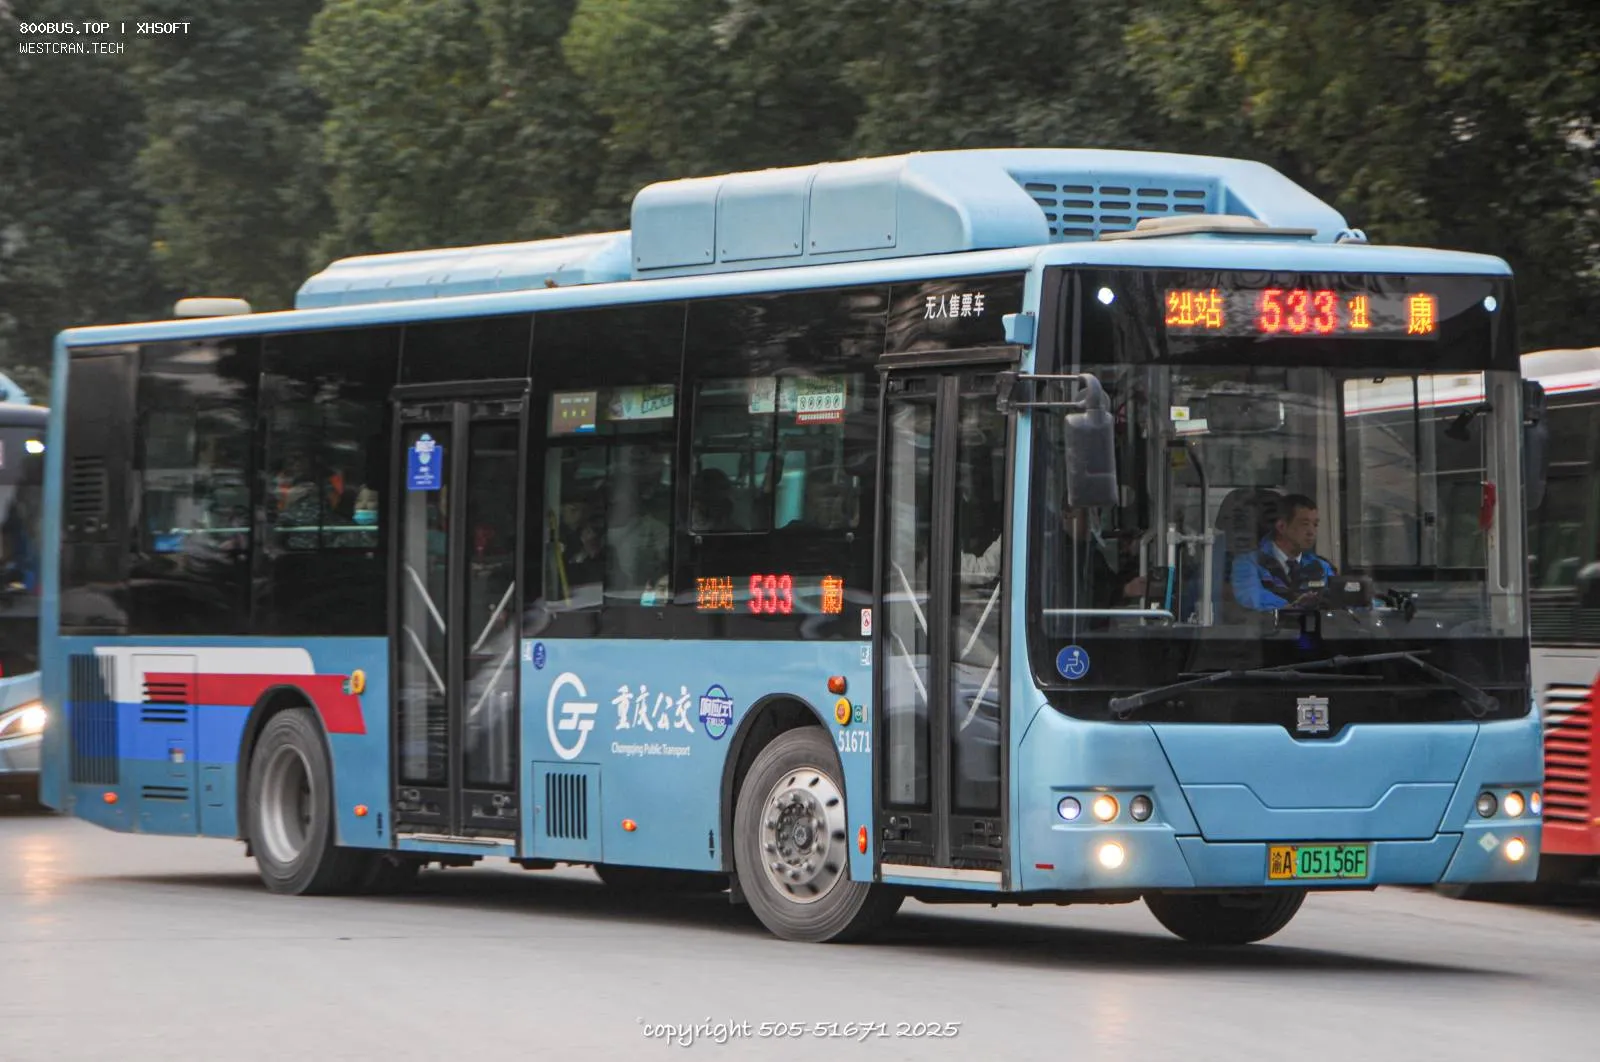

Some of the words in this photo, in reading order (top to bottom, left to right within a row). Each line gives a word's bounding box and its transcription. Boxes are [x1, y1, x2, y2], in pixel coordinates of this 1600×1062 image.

[924, 291, 985, 320] 无人售票车
[1258, 289, 1337, 333] 533
[749, 574, 793, 614] 533
[611, 684, 696, 734] 重庆公交
[837, 730, 871, 753] 51671
[1301, 850, 1366, 874] 05156F
